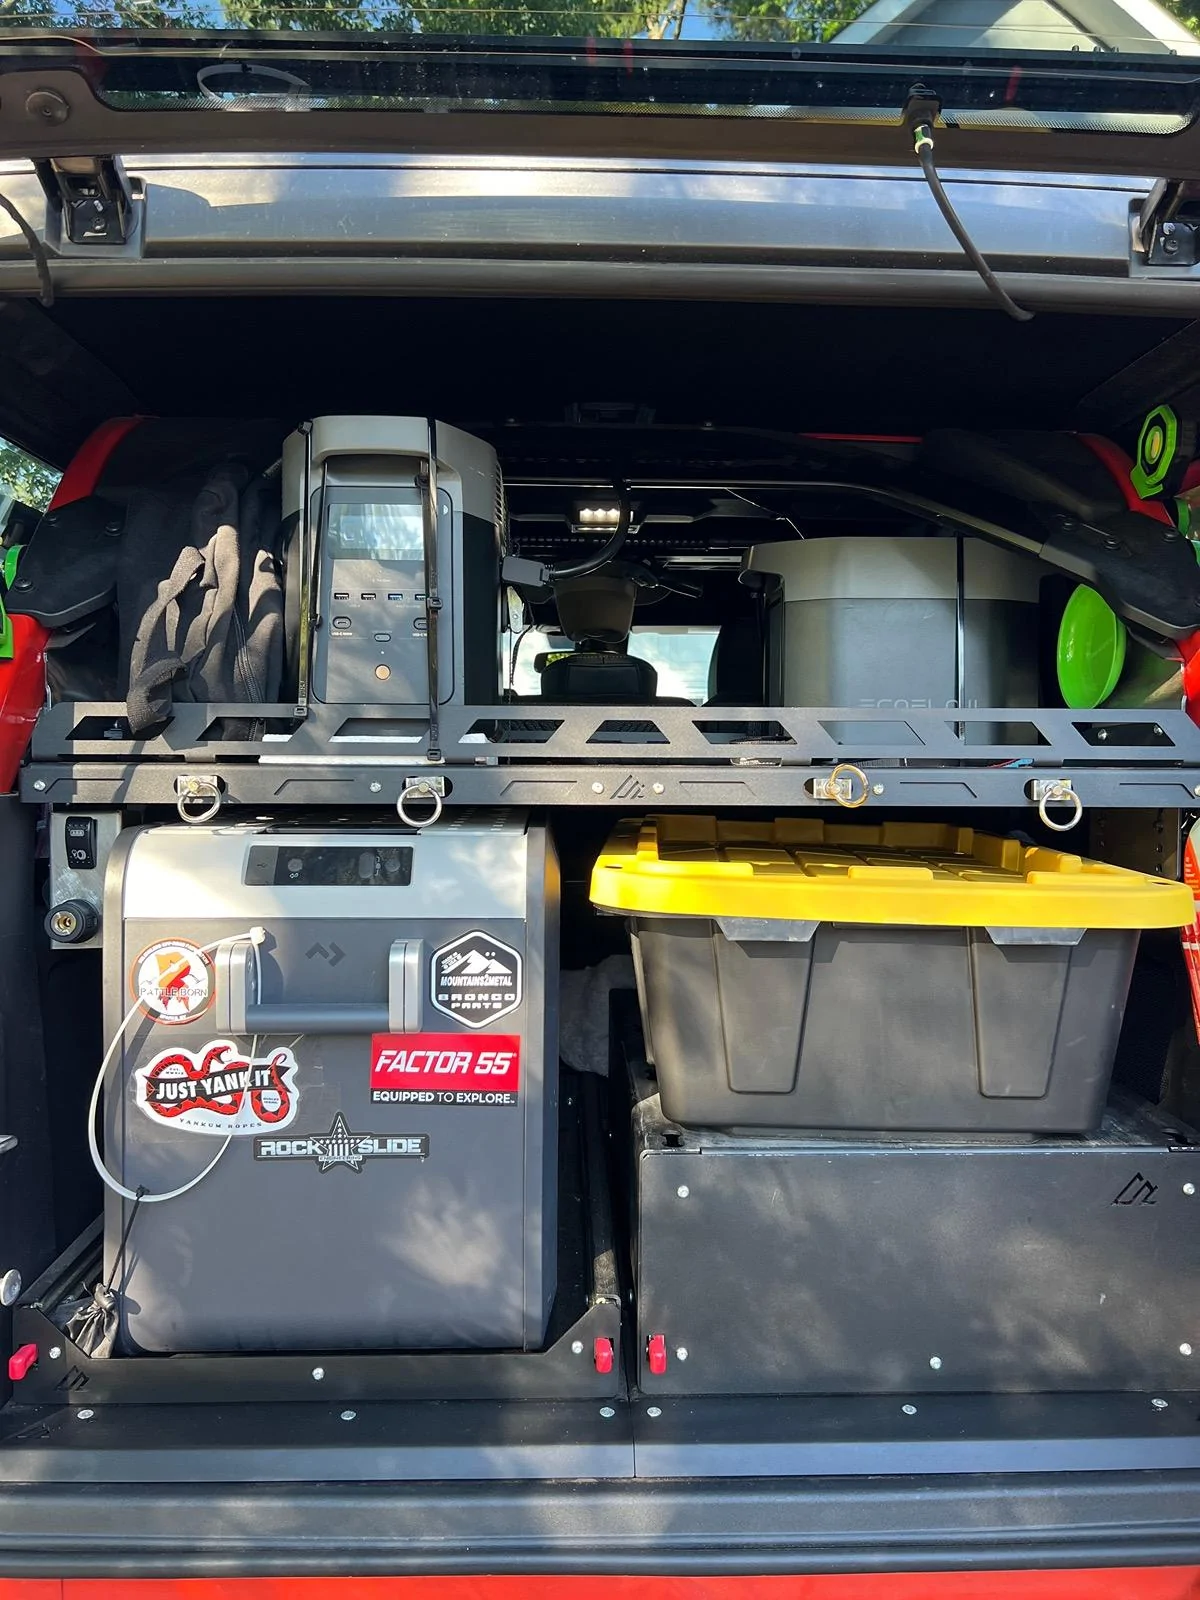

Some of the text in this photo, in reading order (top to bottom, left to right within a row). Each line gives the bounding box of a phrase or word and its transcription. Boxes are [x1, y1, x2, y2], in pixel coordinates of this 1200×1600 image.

[180, 988, 207, 997] BORN
[438, 993, 516, 1001] BRONCO
[374, 1050, 473, 1074] FACTOR
[156, 1068, 272, 1101] JUST YANK IT
[373, 1090, 435, 1103] EQUIPPED
[437, 1091, 454, 1103] TO
[179, 1117, 223, 1129] YANKUM
[260, 1138, 422, 1156] ROCK SLIDE
